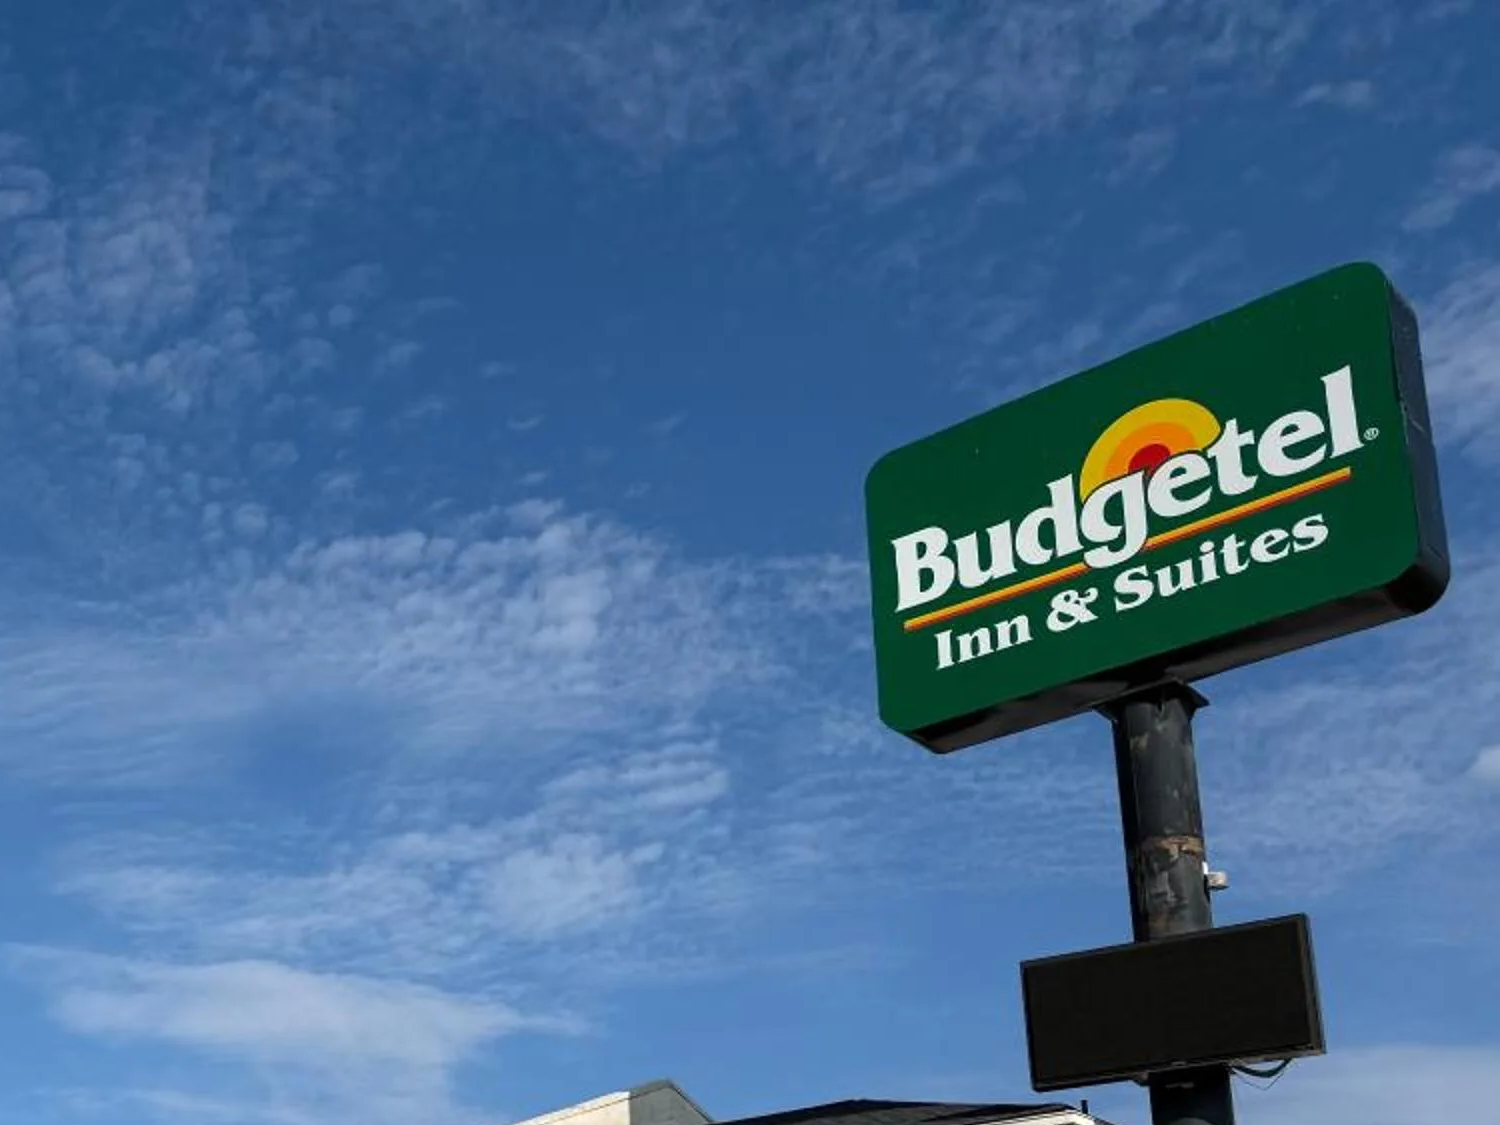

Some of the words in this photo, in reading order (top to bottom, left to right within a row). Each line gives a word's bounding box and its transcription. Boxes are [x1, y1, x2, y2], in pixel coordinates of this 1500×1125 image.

[891, 365, 1365, 613] Budgetel
[935, 614, 1032, 669] Inn
[1046, 587, 1100, 632] &
[1113, 514, 1329, 612] Suites
